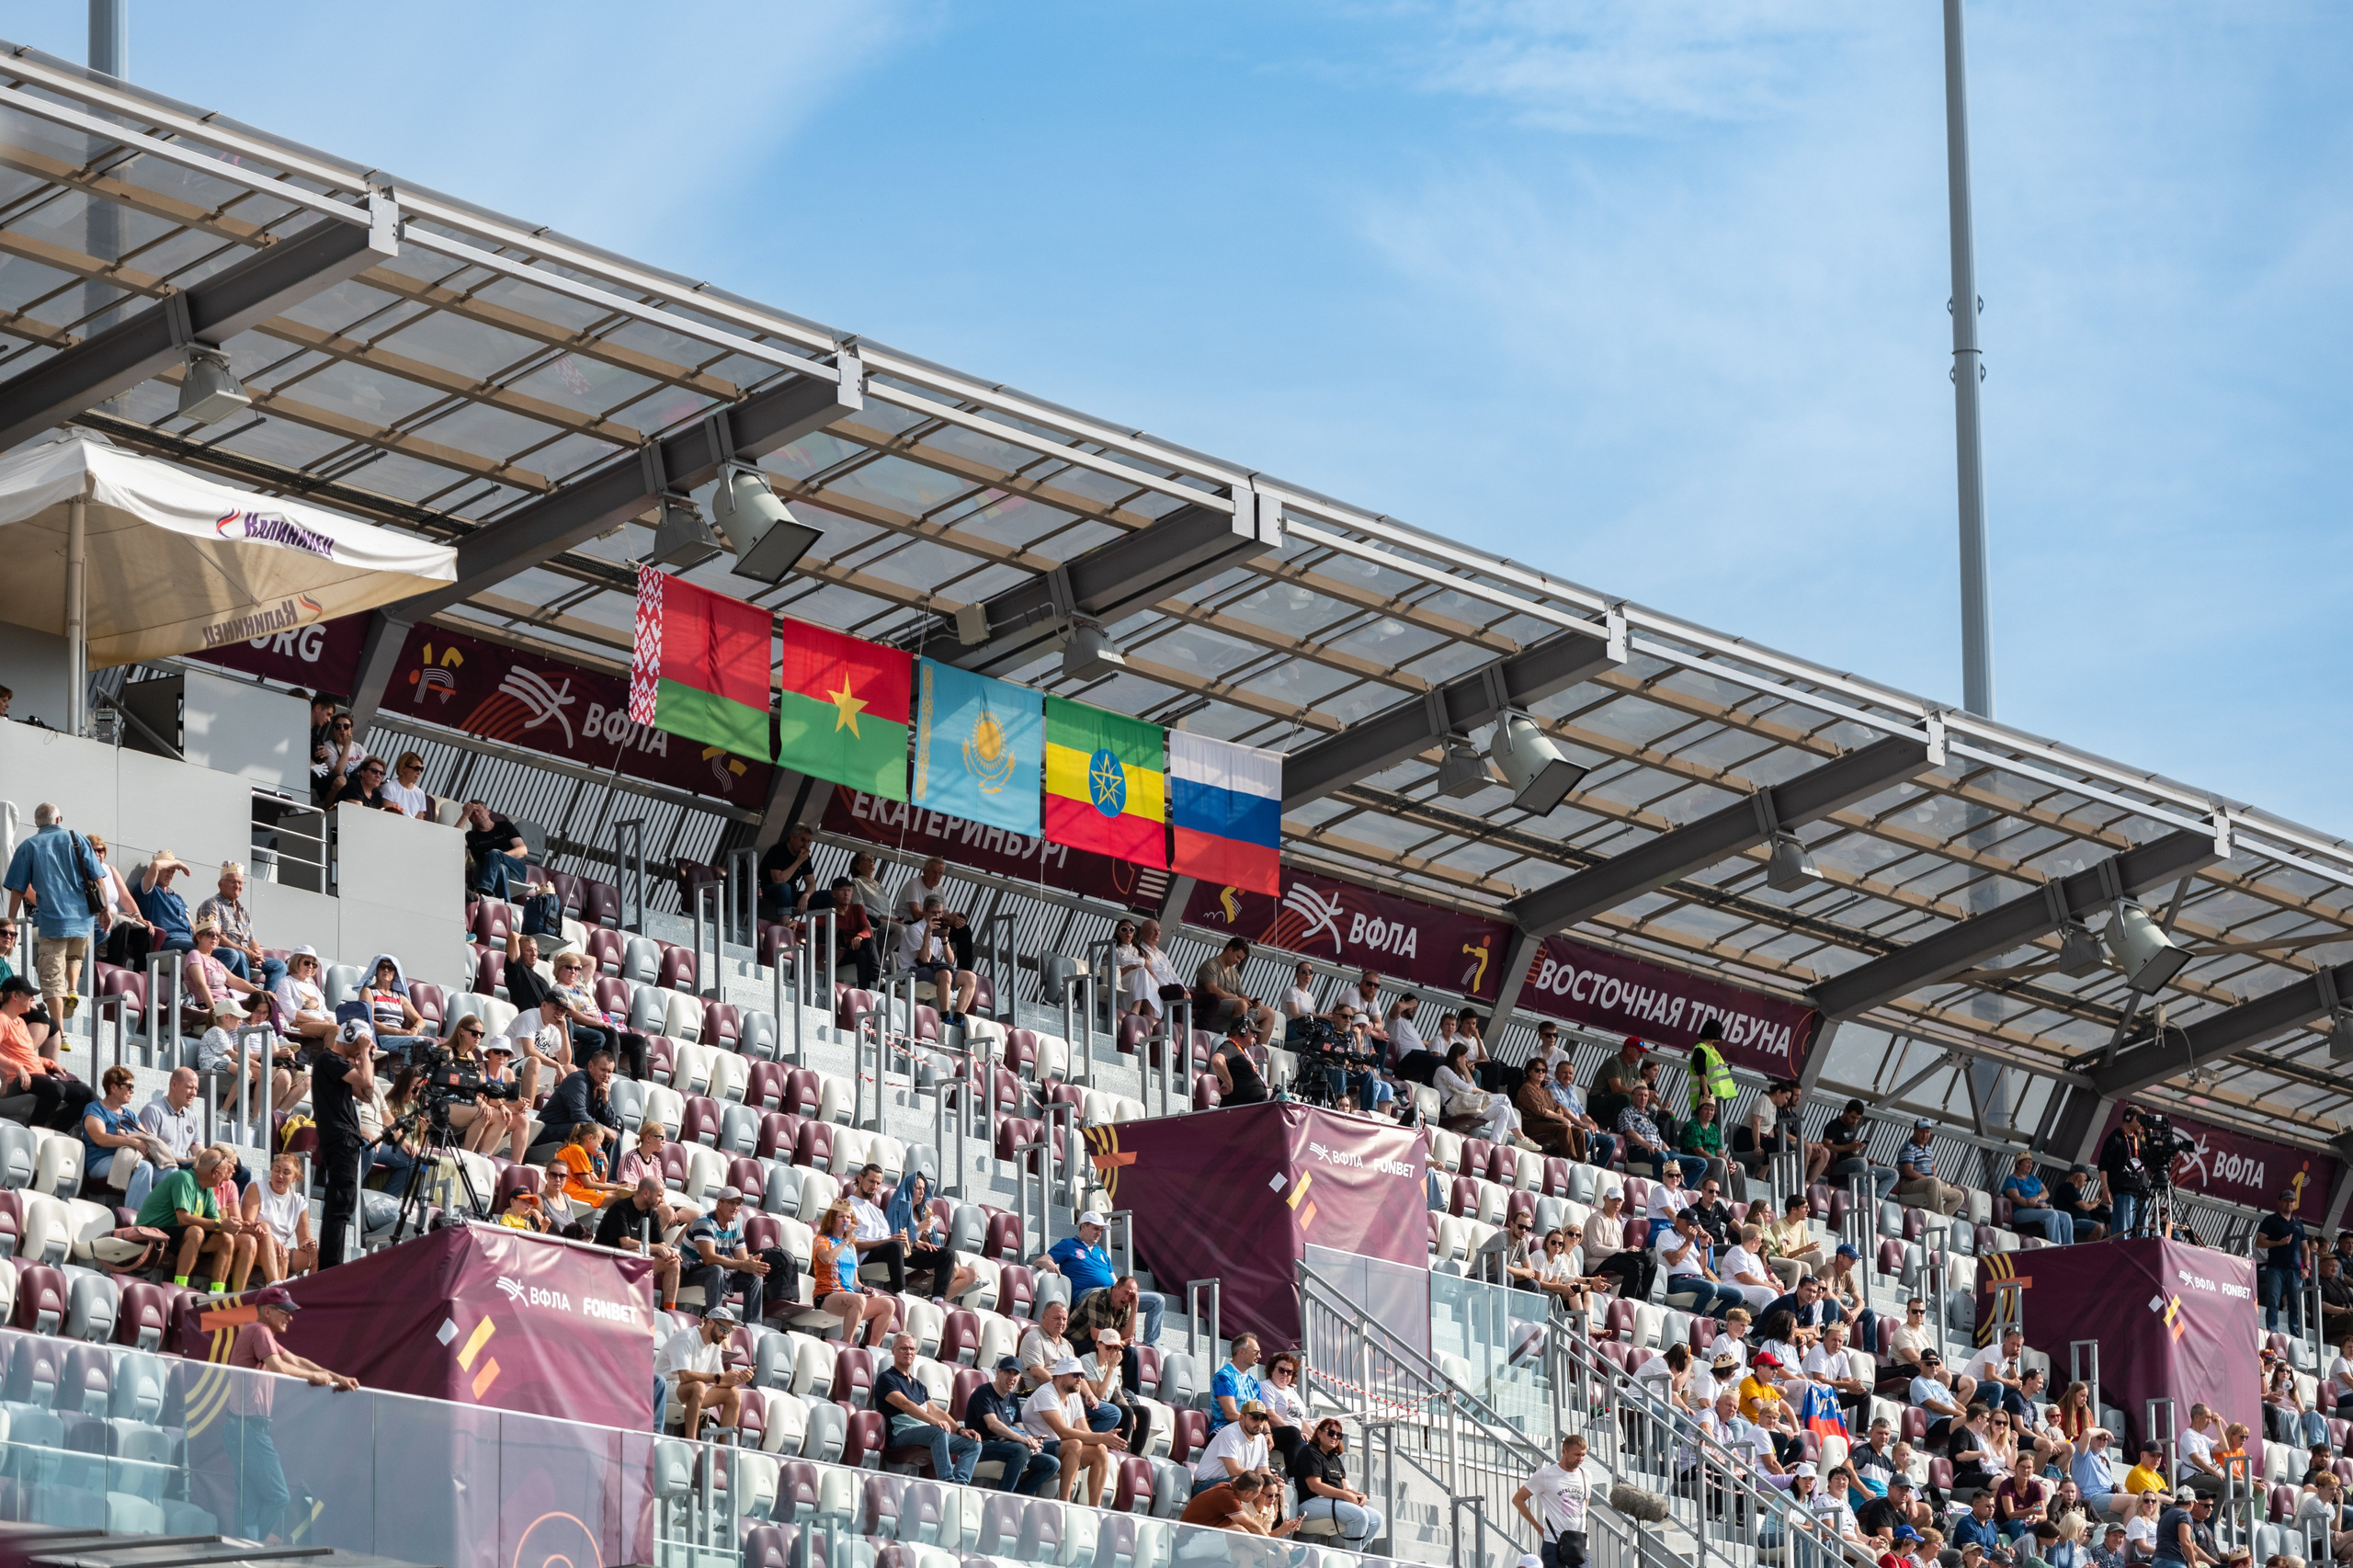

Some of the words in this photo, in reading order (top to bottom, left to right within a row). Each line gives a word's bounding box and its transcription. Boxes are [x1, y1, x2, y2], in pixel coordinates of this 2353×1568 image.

[581, 702, 667, 758] ВФЛА
[1347, 912, 1417, 959] ВФЛА
[1535, 958, 1687, 1028] ВОСТОЧНАЯ
[1687, 1000, 1791, 1057] ТРИБУНА
[1332, 1151, 1364, 1169] ВФЛА
[1373, 1158, 1415, 1178] FONBET
[2211, 1151, 2265, 1189] ВФЛА
[2194, 1277, 2217, 1292] ВФЛА
[2222, 1282, 2252, 1300] FONBET
[529, 1287, 572, 1312] ВФЛА
[583, 1297, 638, 1324] FONBET
